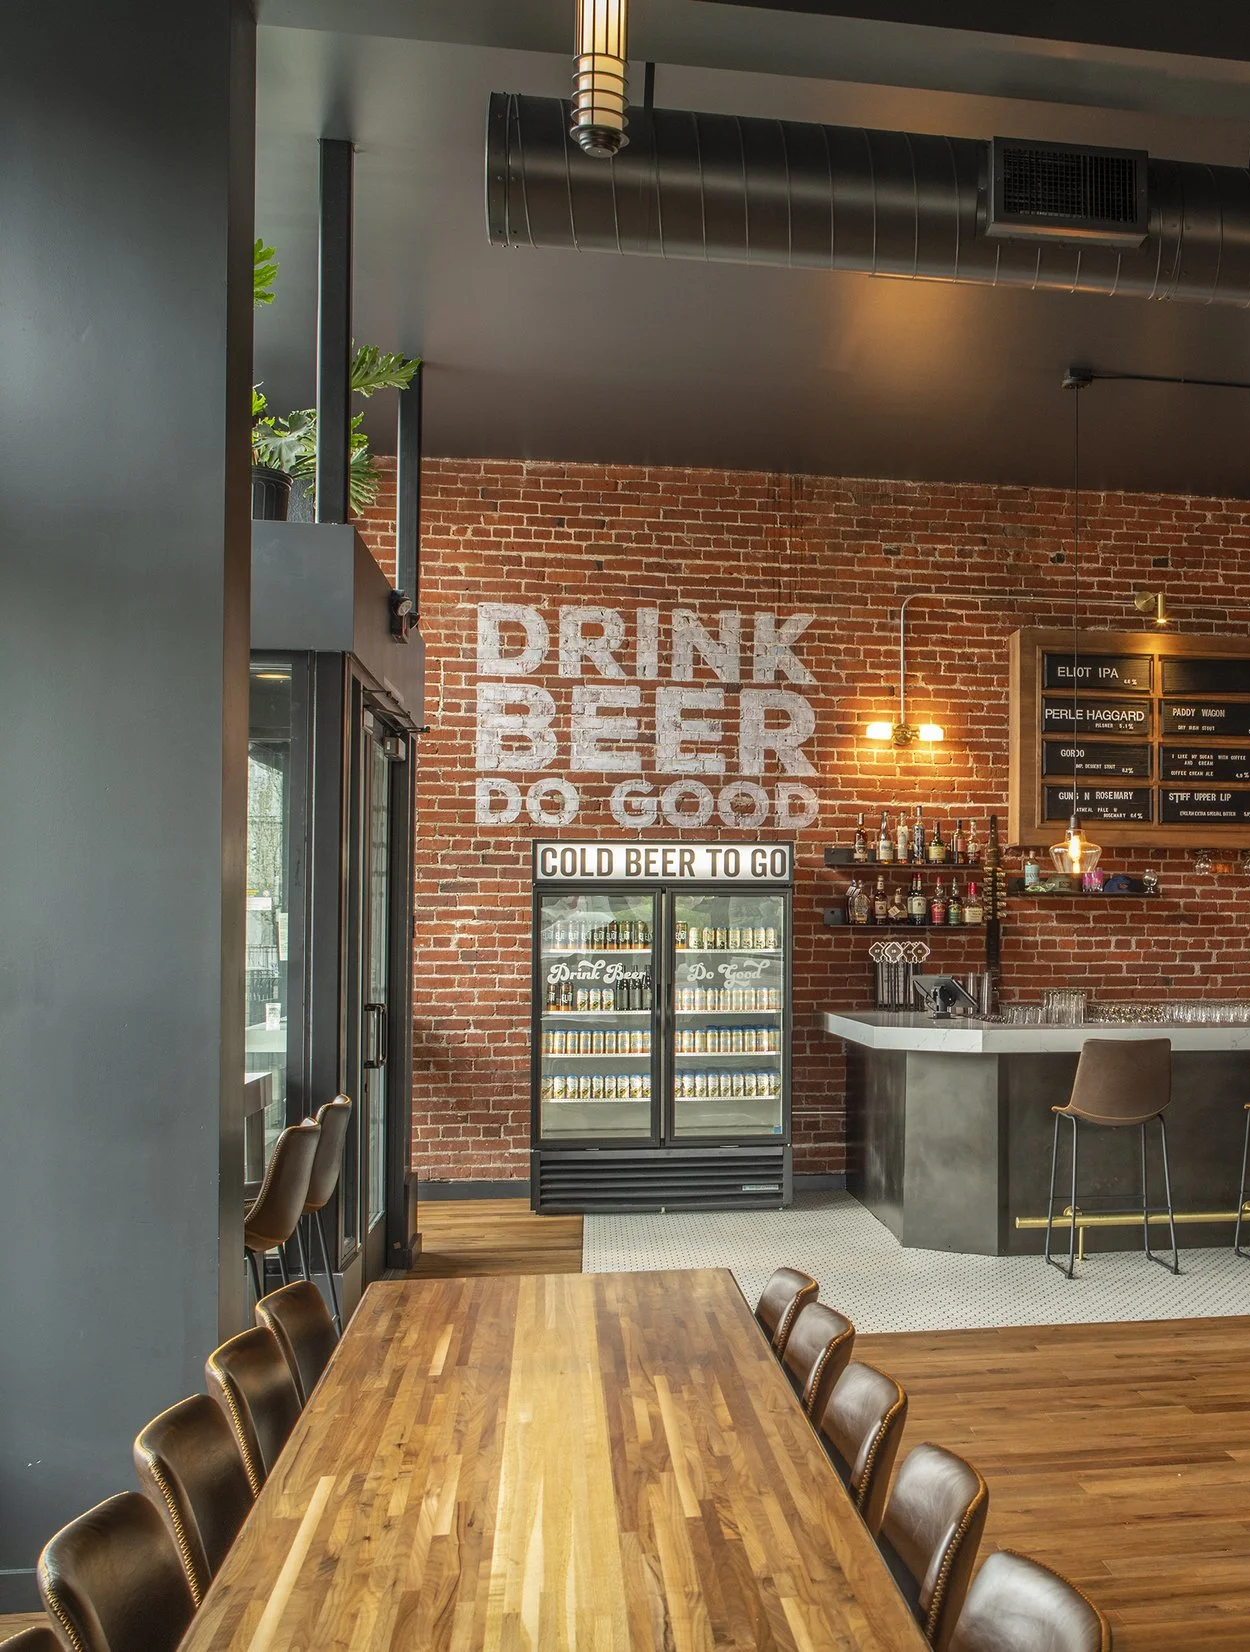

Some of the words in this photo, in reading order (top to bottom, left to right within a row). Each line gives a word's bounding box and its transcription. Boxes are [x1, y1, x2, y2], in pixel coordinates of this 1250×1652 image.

[477, 602, 817, 684] DRINK
[1057, 666, 1092, 678] ELIOT
[1099, 667, 1119, 678] IPA
[1045, 708, 1084, 720] PERLE
[1086, 710, 1145, 722] HAGGARD
[1172, 708, 1196, 717] PADDY
[1201, 708, 1225, 718] WAGON
[475, 682, 817, 777] BEER
[1060, 749, 1085, 758] GORDO
[475, 778, 580, 826] DO
[610, 780, 818, 828] GOOD
[1084, 792, 1090, 800] N
[1095, 791, 1134, 800] ROSEMARY
[1169, 792, 1190, 803] STIFF
[1194, 793, 1216, 801] UPPER
[1220, 793, 1232, 801] LIP
[540, 847, 613, 877] COLD
[626, 848, 695, 877] BEER
[706, 848, 740, 877] TO
[751, 848, 787, 877] GO
[547, 959, 606, 984] Drink
[603, 962, 646, 984] Beer
[687, 962, 714, 981] Do
[718, 959, 770, 988] Good
